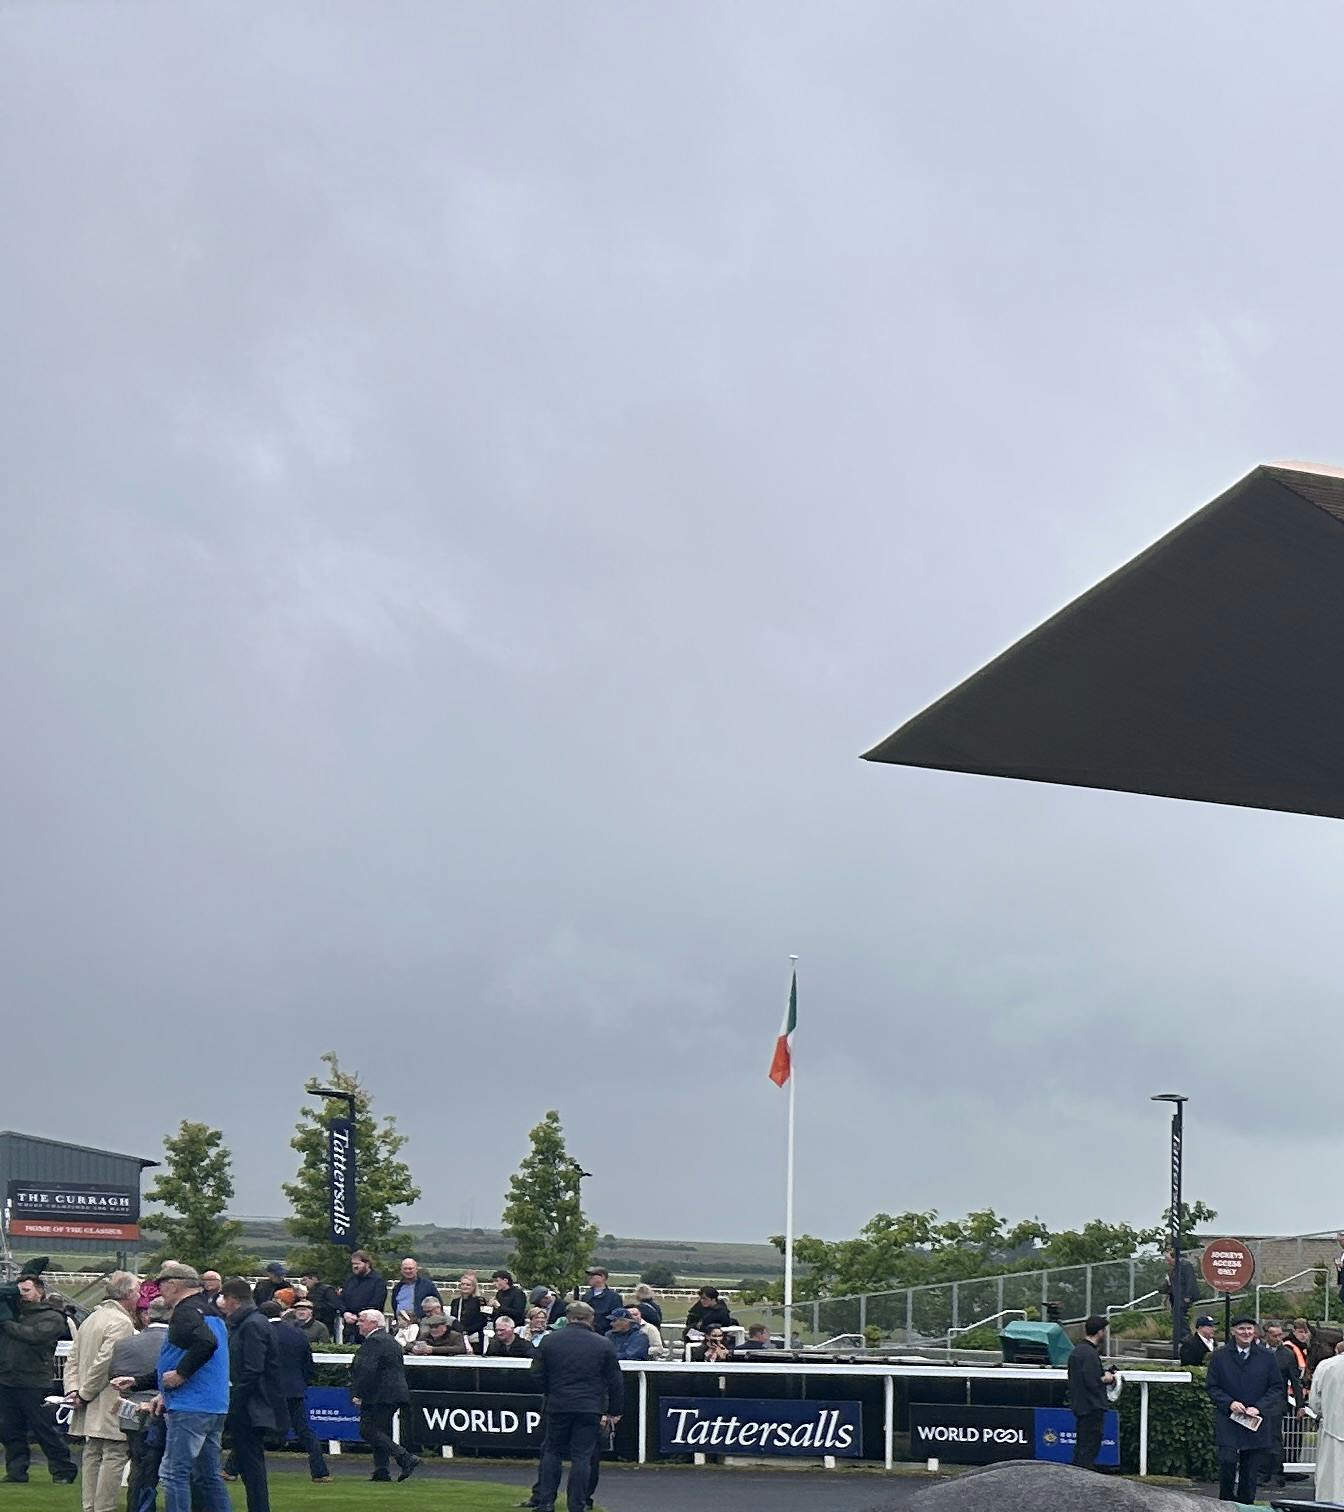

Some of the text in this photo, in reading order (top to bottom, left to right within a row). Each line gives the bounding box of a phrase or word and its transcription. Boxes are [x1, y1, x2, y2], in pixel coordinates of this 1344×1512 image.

[333, 1128, 351, 1236] Tattersalls
[17, 1193, 129, 1206] THE CURRAGH
[422, 1406, 519, 1434] WORLD
[666, 1407, 854, 1449] Tattersalls
[917, 1426, 1028, 1444] WORLD POOL
